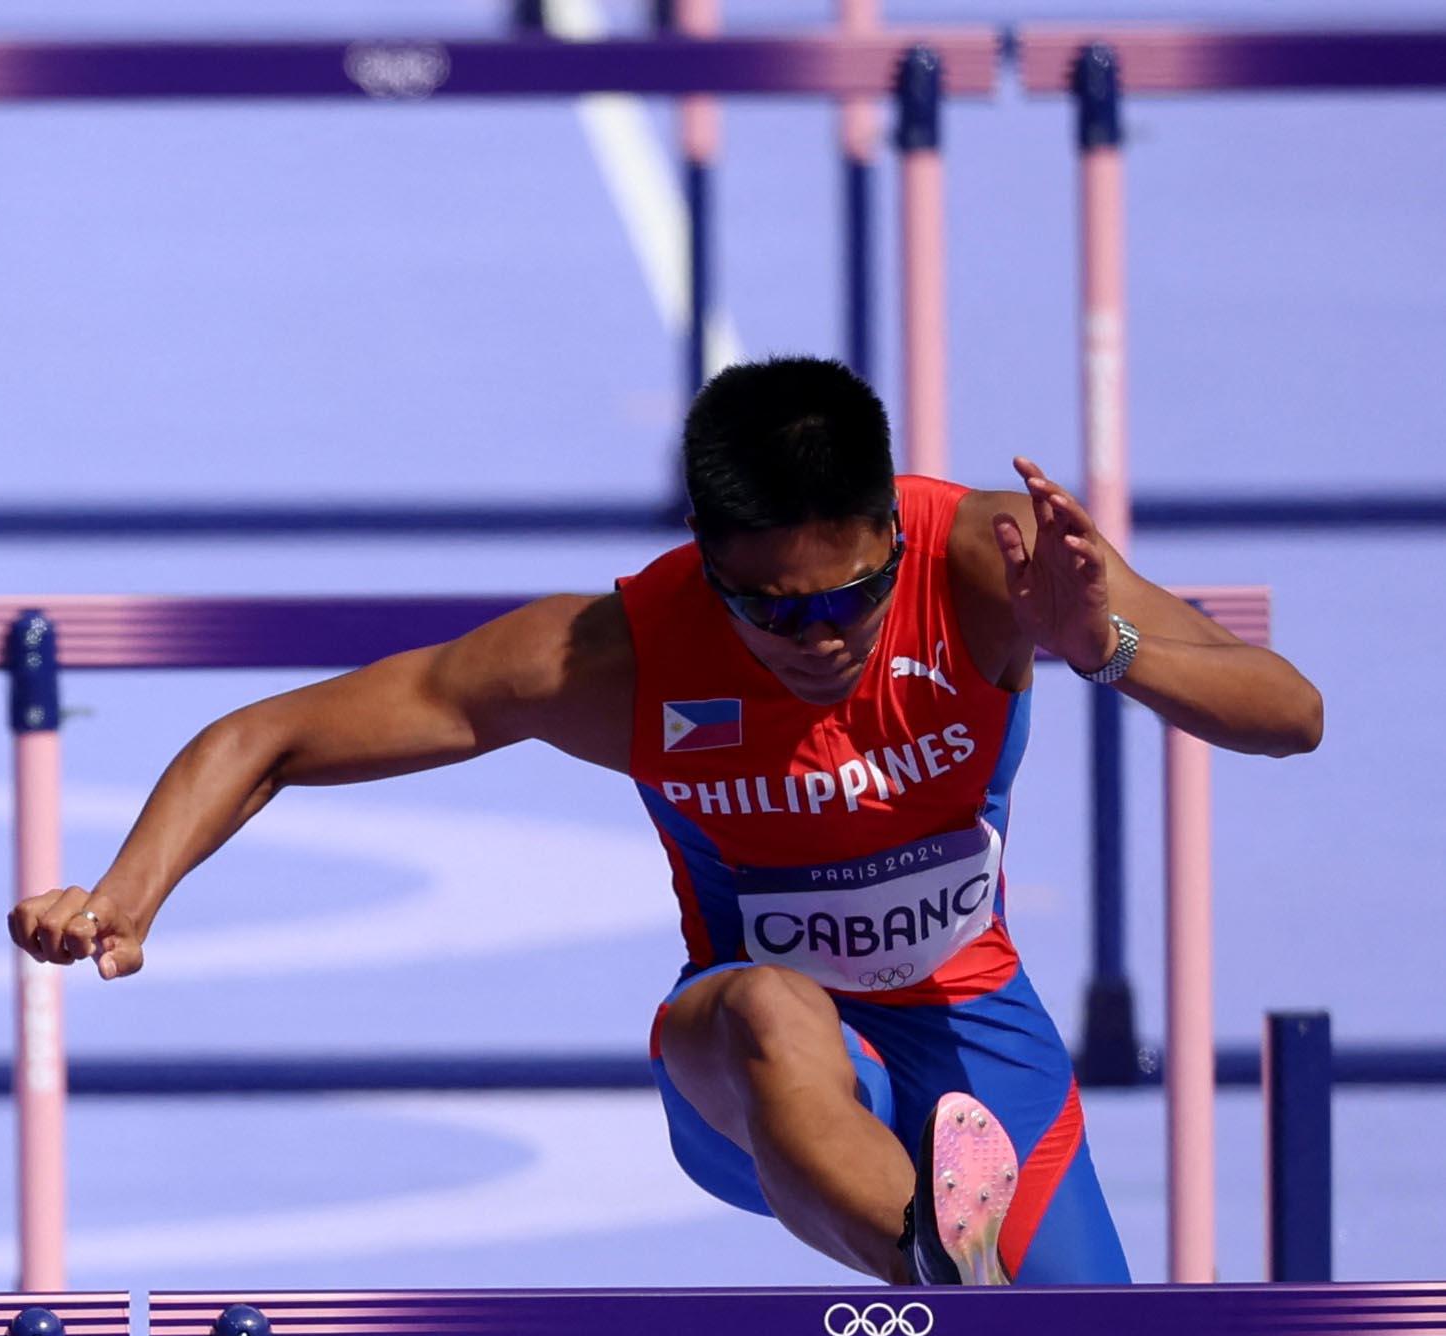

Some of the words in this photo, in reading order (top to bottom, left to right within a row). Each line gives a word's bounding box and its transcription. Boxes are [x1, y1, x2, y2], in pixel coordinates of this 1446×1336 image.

[661, 723, 976, 815] PHILIPPINES
[811, 863, 878, 882] PARIS
[886, 843, 944, 873] 2024
